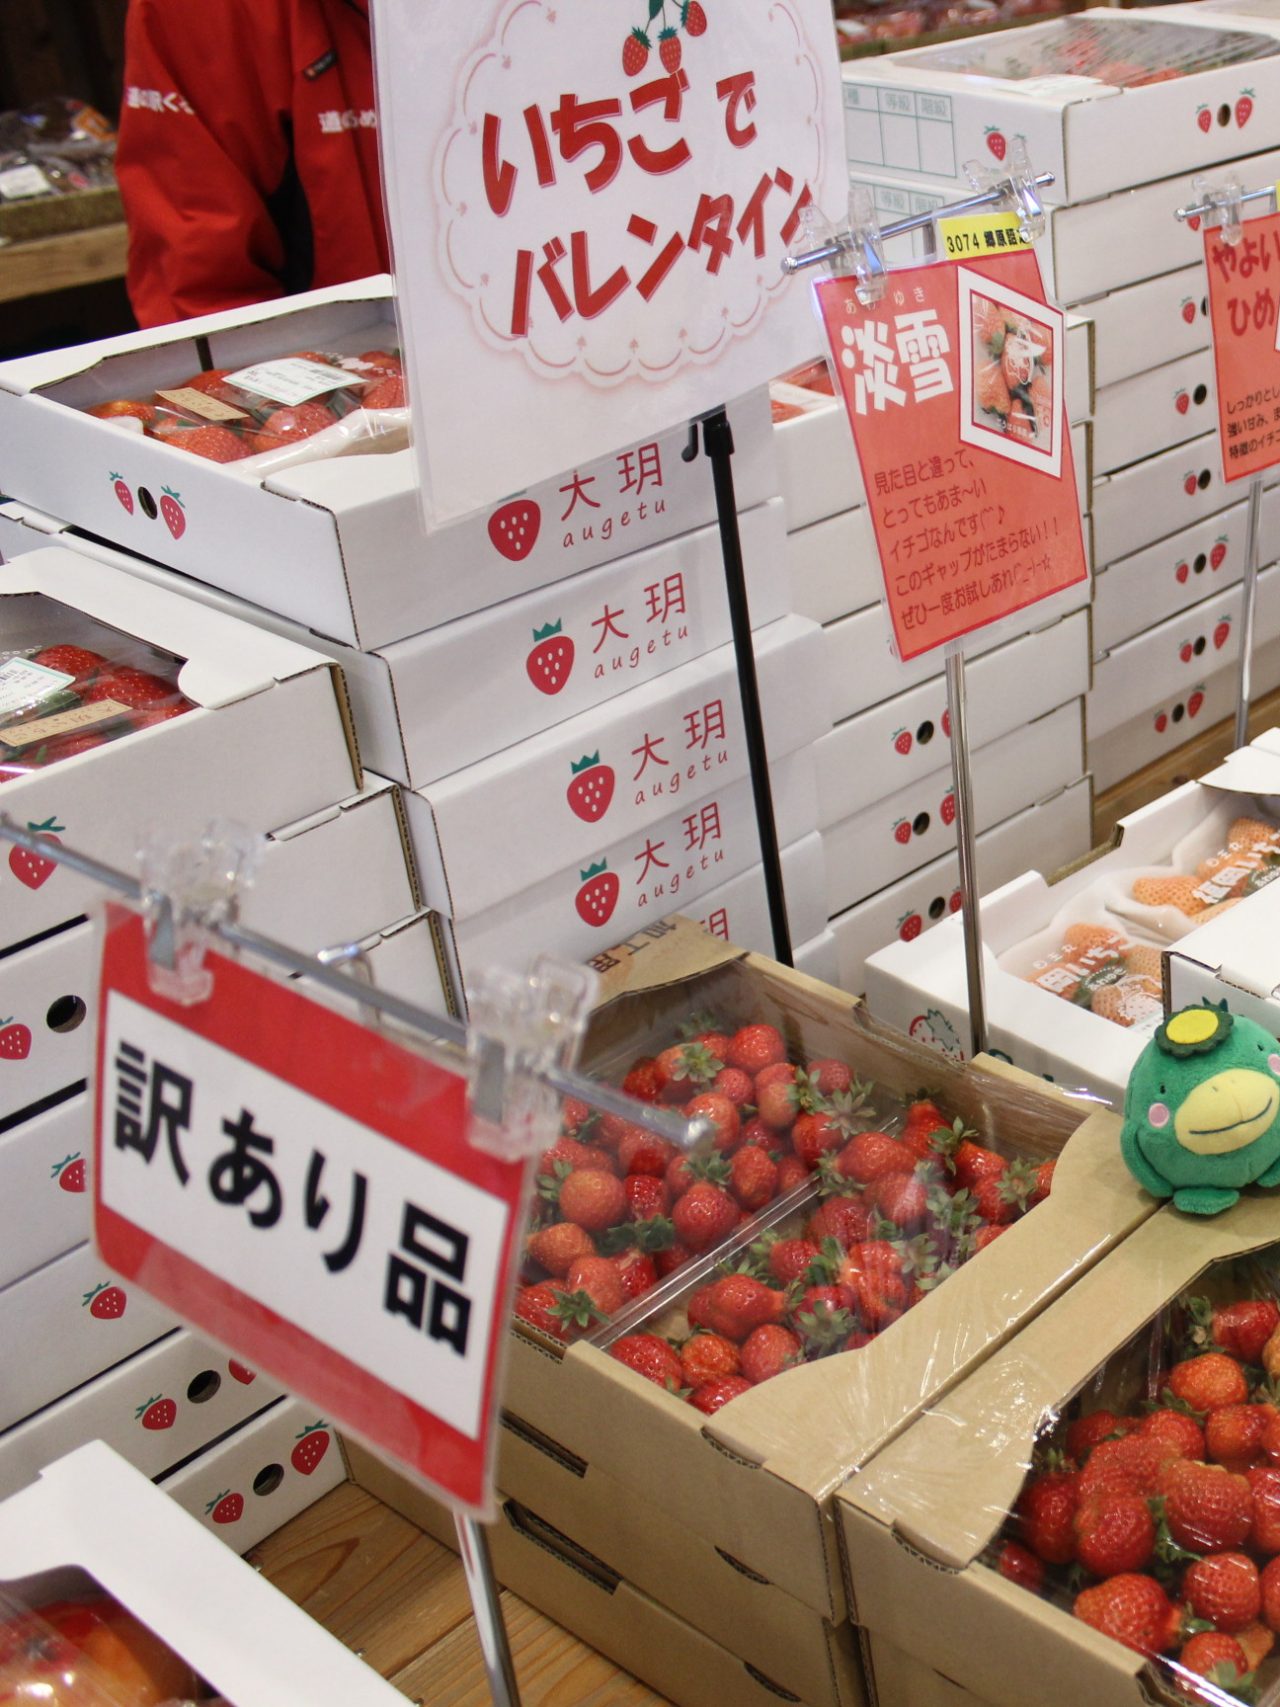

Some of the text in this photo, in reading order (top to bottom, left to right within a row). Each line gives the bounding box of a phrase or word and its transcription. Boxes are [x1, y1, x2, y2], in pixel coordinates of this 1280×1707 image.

[482, 68, 757, 218] いちごで
[511, 167, 812, 338] バレンタイン
[946, 231, 980, 254] 3074
[1226, 287, 1276, 337] ひめ
[840, 308, 954, 416] 淡雪
[559, 441, 665, 522] 大玥
[875, 449, 975, 497] 見た目と違って、
[561, 496, 669, 551] augetu
[590, 572, 687, 655] 大玥
[593, 622, 691, 680] augetu
[631, 699, 728, 783] 大玥
[633, 748, 731, 807] augetu
[633, 801, 724, 887] 大玥
[637, 849, 727, 910] augetu
[114, 1041, 472, 1358] 訳あり品
